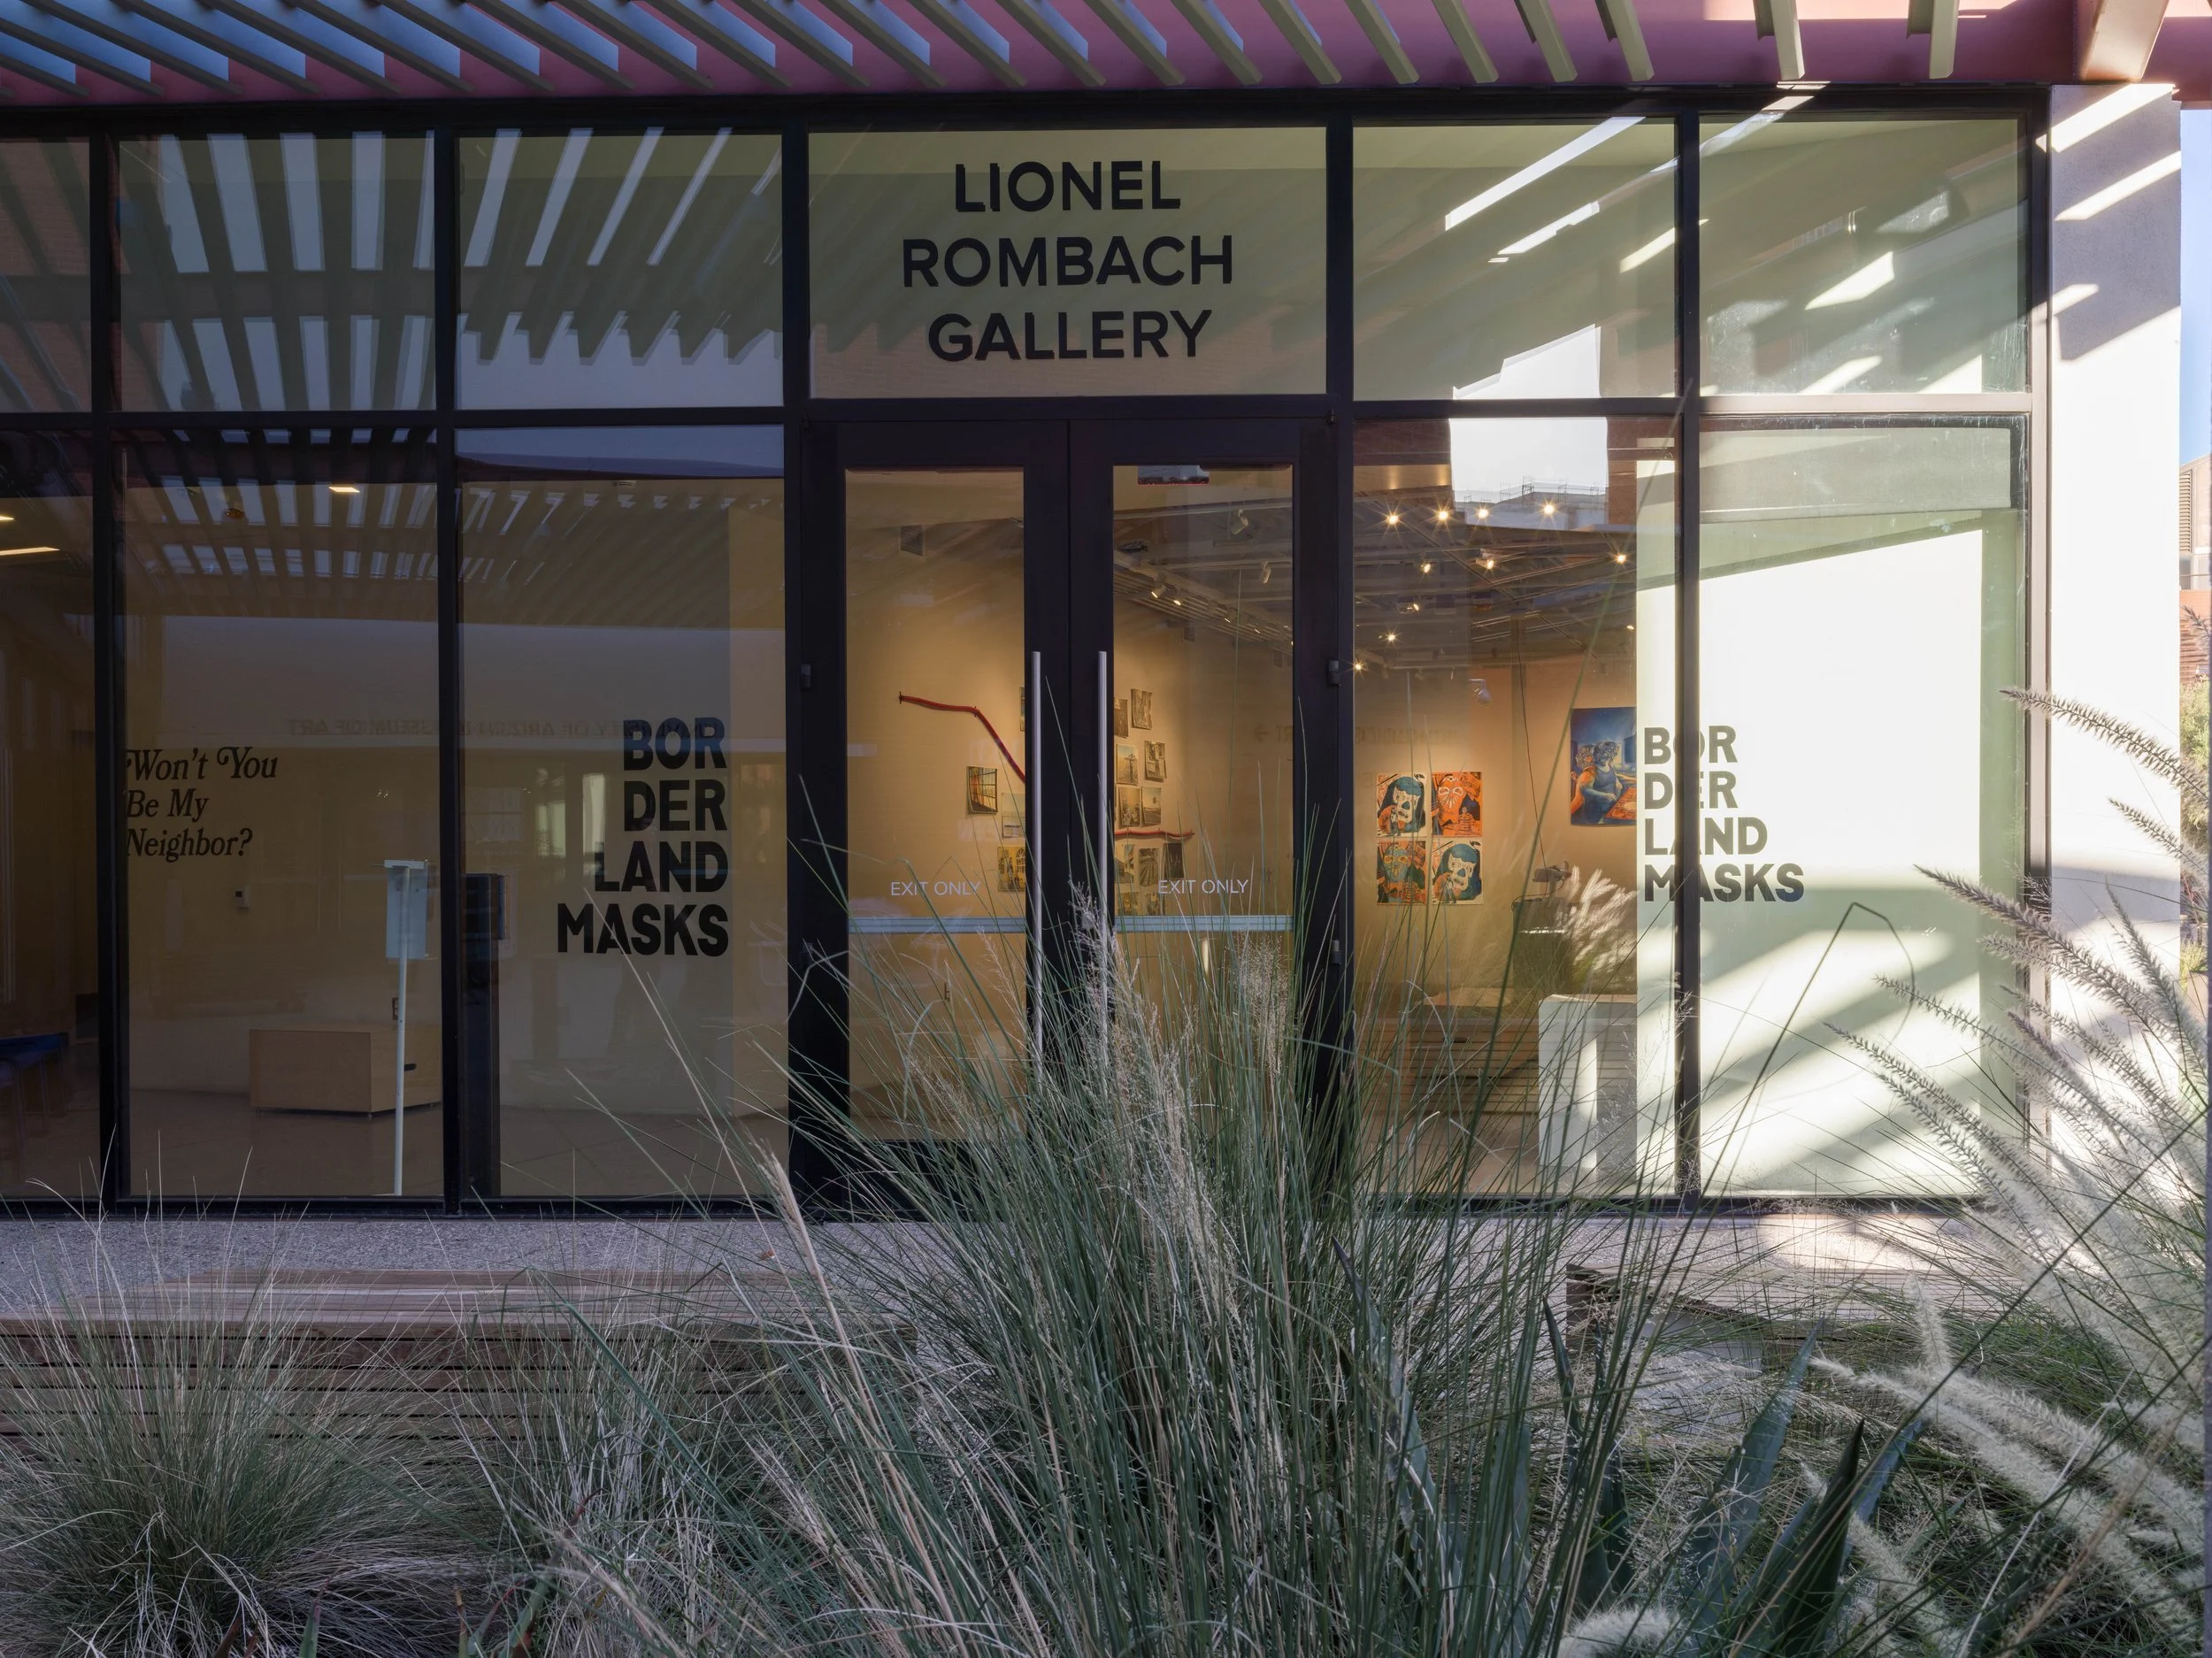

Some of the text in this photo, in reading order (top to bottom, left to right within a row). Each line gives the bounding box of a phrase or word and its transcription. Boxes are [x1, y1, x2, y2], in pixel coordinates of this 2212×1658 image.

[955, 160, 1181, 212] LIONEL
[902, 234, 1233, 288] ROMBACH
[928, 310, 1212, 362] GALLERY
[125, 746, 280, 781] Won't You
[623, 717, 727, 771] BOR
[1644, 725, 1739, 765] BR
[126, 787, 210, 823] Be My
[624, 779, 727, 832] DER
[1644, 771, 1740, 810] DR
[126, 827, 254, 864] Neighbor?
[1644, 817, 1769, 856] LND
[595, 841, 728, 894] LAND
[1158, 878, 1249, 894] EXIT ONLY
[890, 880, 981, 896] EXIT ONLY
[557, 903, 729, 957] MASKS
